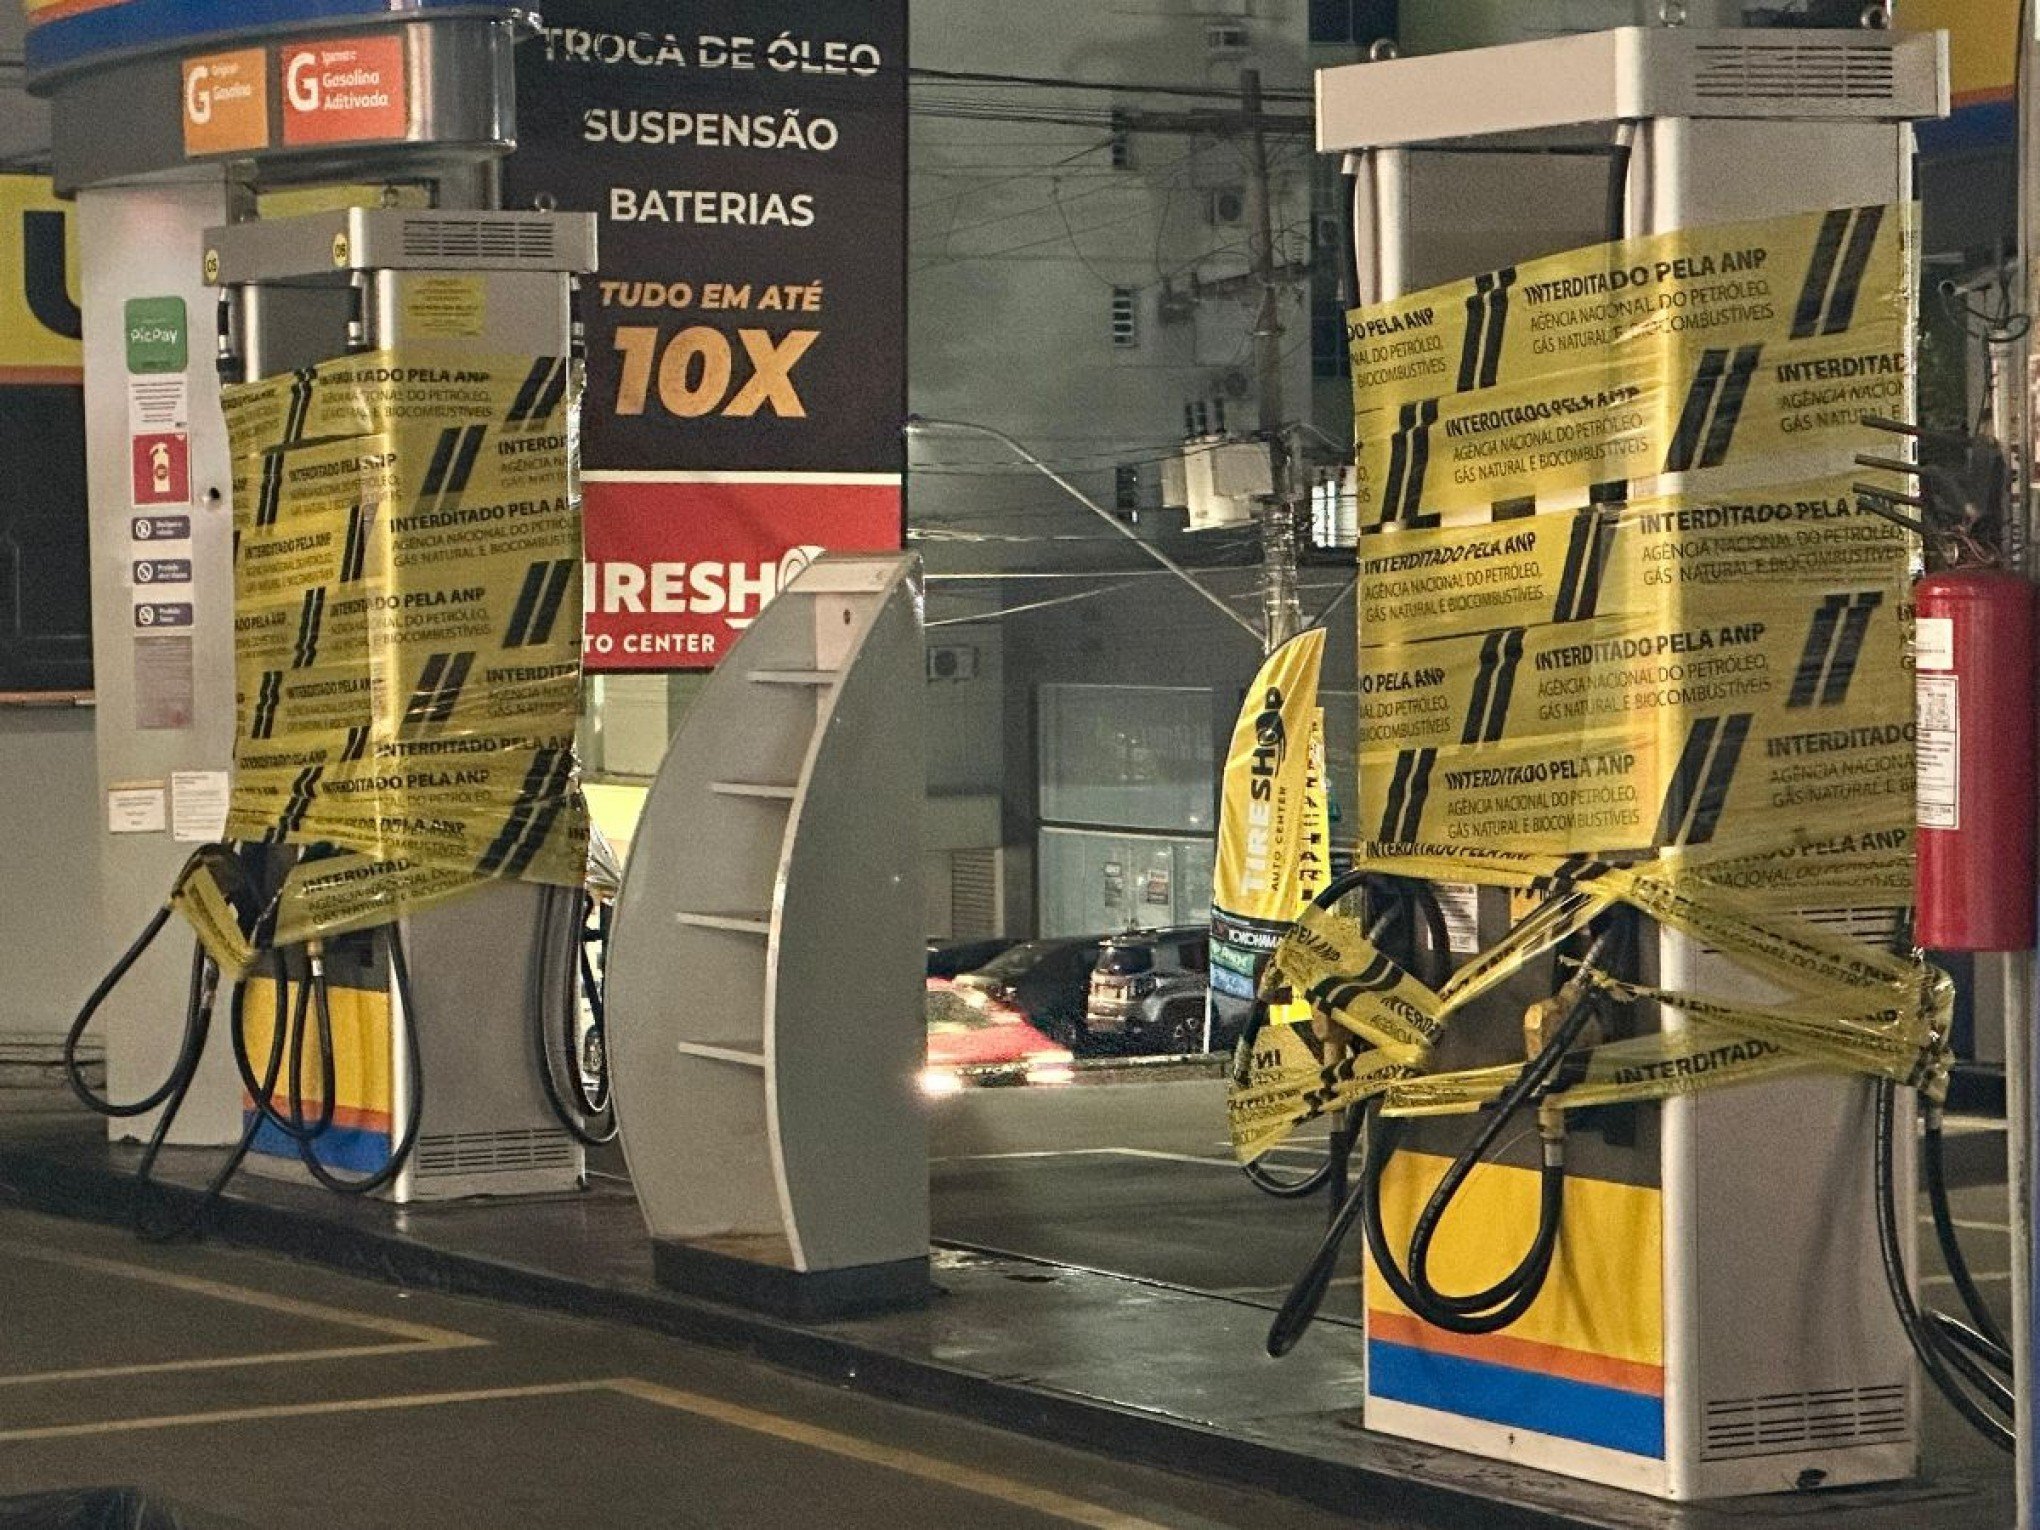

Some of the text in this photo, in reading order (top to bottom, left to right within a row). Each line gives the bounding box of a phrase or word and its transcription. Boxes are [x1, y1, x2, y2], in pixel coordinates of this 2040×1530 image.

[538, 27, 882, 76] TROCA DE ÓLEO
[287, 52, 320, 112] G
[322, 68, 381, 88] Gasolina
[186, 65, 212, 125] G
[323, 92, 390, 111] Aditivada
[583, 108, 839, 152] SUSPENSÃO
[609, 187, 815, 228] BATERIAS
[1524, 247, 1768, 306] INTERDITADO PELA ANP
[600, 280, 824, 312] TUDO EM ATÉ
[1579, 294, 1656, 326] NACIONAL
[1657, 291, 1687, 311] DO
[130, 328, 179, 345] PicPay
[1367, 315, 1403, 339] PELA
[1404, 307, 1435, 330] ANP
[1532, 336, 1556, 356] GÁS
[1558, 327, 1611, 352] NATURAL
[1629, 303, 1774, 338] COMBUSTÍVEIS
[1373, 343, 1389, 363] DO
[408, 367, 490, 383] PELA ANP
[613, 325, 821, 419] 10X
[1446, 400, 1551, 438] INTERDITADO
[1780, 412, 1813, 434] GÁS
[1499, 427, 1556, 453] NACIONAL
[1557, 422, 1575, 444] DO
[1454, 465, 1476, 485] GÁS
[1478, 456, 1528, 481] NATURAL
[390, 504, 505, 533] INTERDITADO
[508, 498, 551, 518] PELA
[1639, 502, 1792, 535] INTERDITADO
[1795, 498, 1851, 521] PELA
[1364, 531, 1537, 576] INTERDITADO PELA ANP
[1641, 538, 1710, 563] AGÊNCIA
[1364, 578, 1410, 602] AGÊNCIA
[1410, 571, 1465, 596] NACIONAL
[1466, 568, 1484, 588] DO
[1643, 565, 1673, 586] GÁS
[1680, 558, 1751, 583] NATURAL
[404, 591, 448, 608] PELA
[450, 587, 486, 604] ANP
[1366, 604, 1387, 624] GÁS
[1389, 598, 1438, 621] NATURAL
[622, 633, 716, 653] CENTER
[1535, 621, 1766, 672] INTERDITADO PELA ANP
[1376, 667, 1446, 693] PELA ANP
[1587, 665, 1657, 691] NACIONAL
[1658, 664, 1684, 683] DO
[1377, 701, 1394, 718] DO
[1766, 722, 1916, 759] INTERDITADO
[407, 771, 451, 788] PELA
[455, 769, 491, 785] ANP
[1445, 753, 1636, 791] INTERDITADO PELA ANP
[1494, 790, 1550, 814] NACIONAL
[1551, 790, 1570, 808] DO
[1271, 785, 1287, 892] AUTO CENTER
[1448, 817, 1471, 839] GÁS
[1472, 815, 1521, 837] NATURAL
[1860, 828, 1908, 851] ANP
